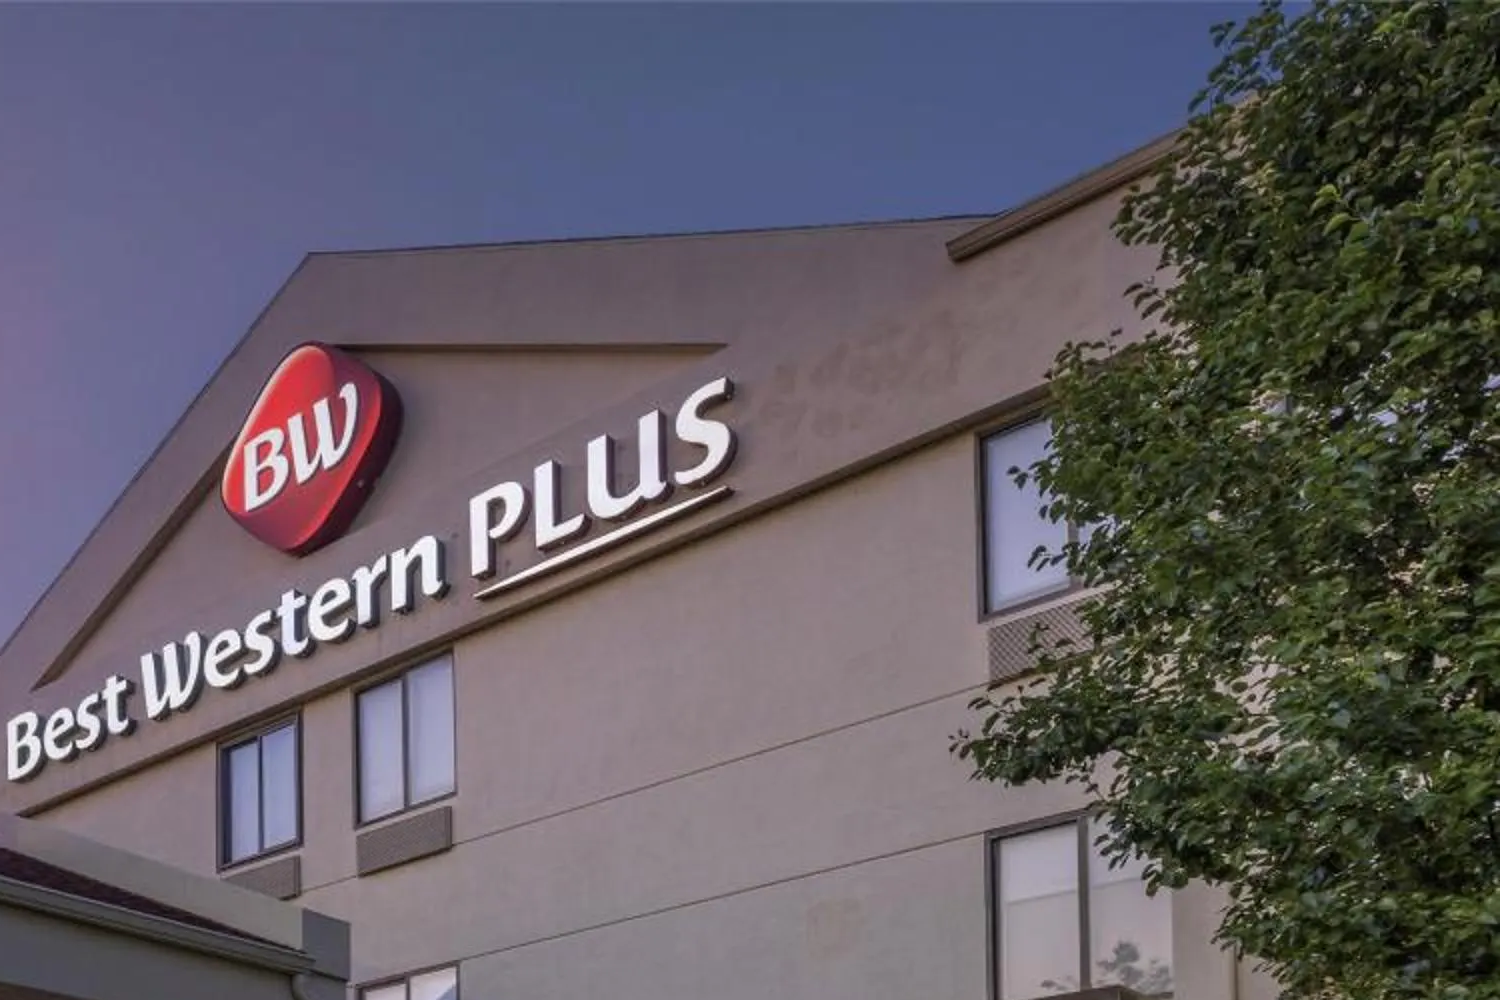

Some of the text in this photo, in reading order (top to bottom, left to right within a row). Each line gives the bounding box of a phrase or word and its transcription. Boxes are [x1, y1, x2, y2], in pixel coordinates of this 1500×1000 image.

[6, 377, 732, 781] Best Western PLUS
[244, 382, 358, 511] BW
